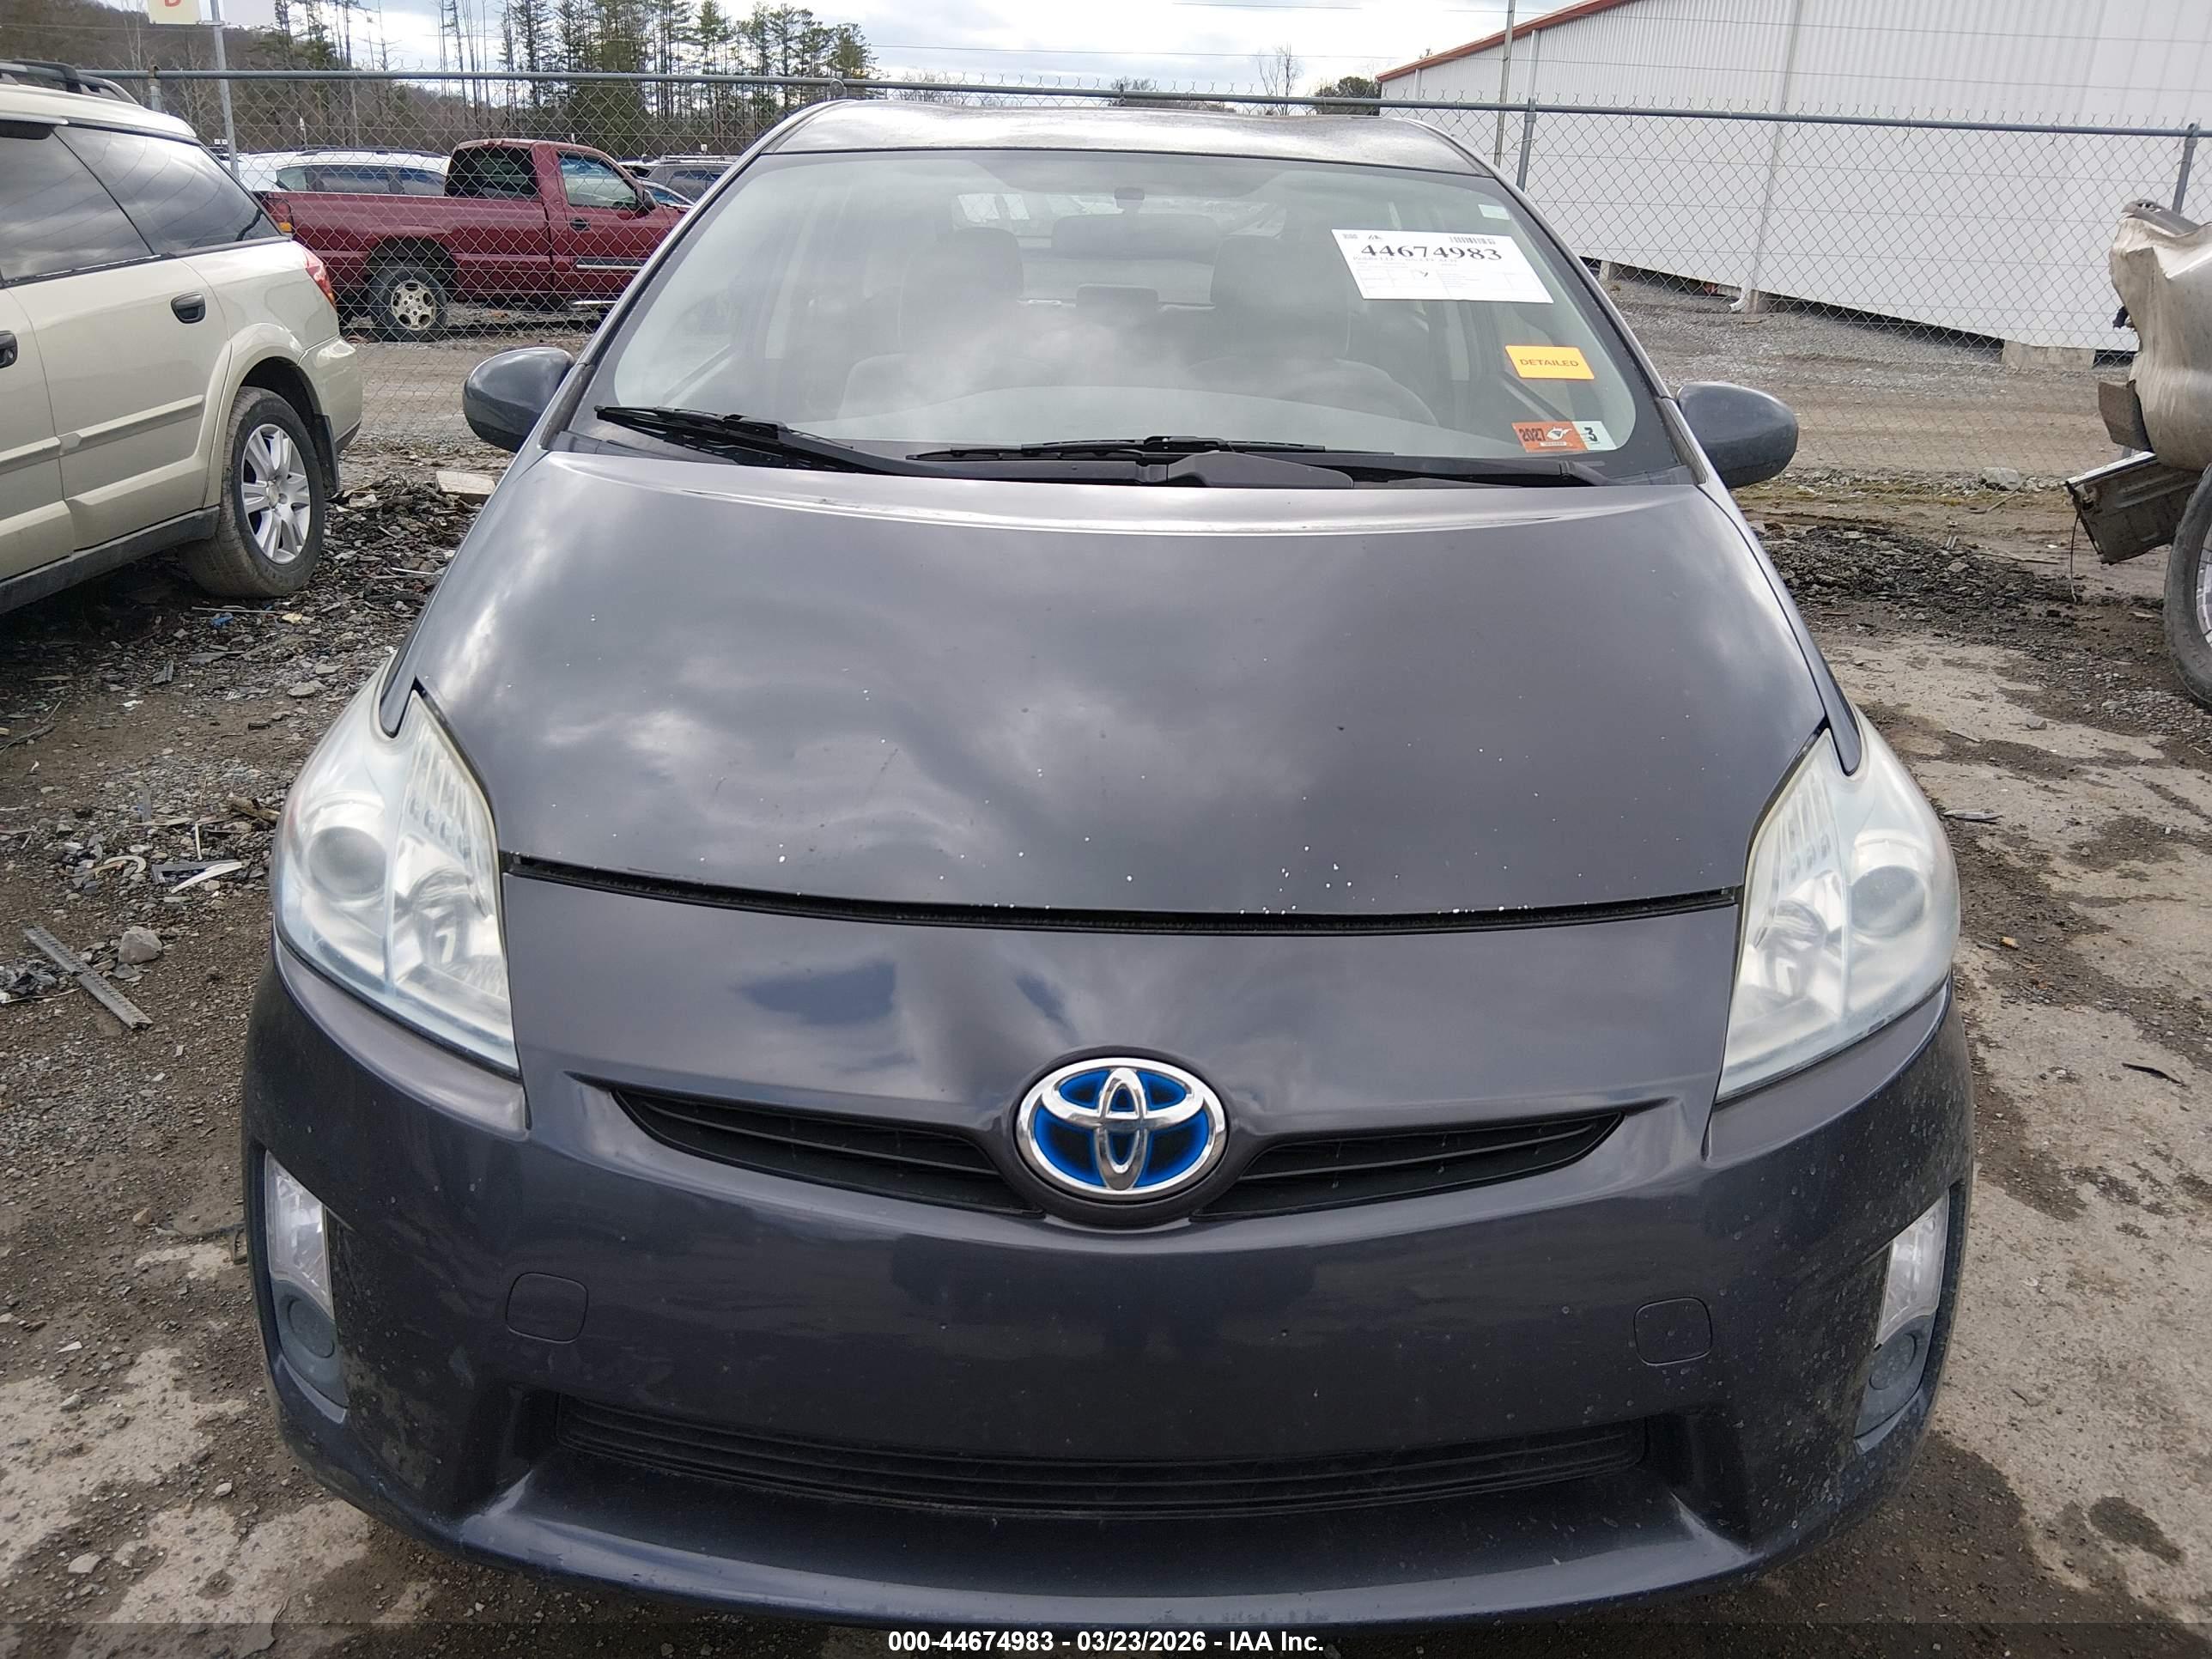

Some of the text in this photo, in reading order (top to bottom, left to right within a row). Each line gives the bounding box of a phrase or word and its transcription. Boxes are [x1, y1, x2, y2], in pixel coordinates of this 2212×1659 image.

[1361, 244, 1503, 261] 44674983
[1519, 358, 1580, 368] DETAILED
[1518, 428, 1546, 442] 2027
[1583, 427, 1598, 442] 3
